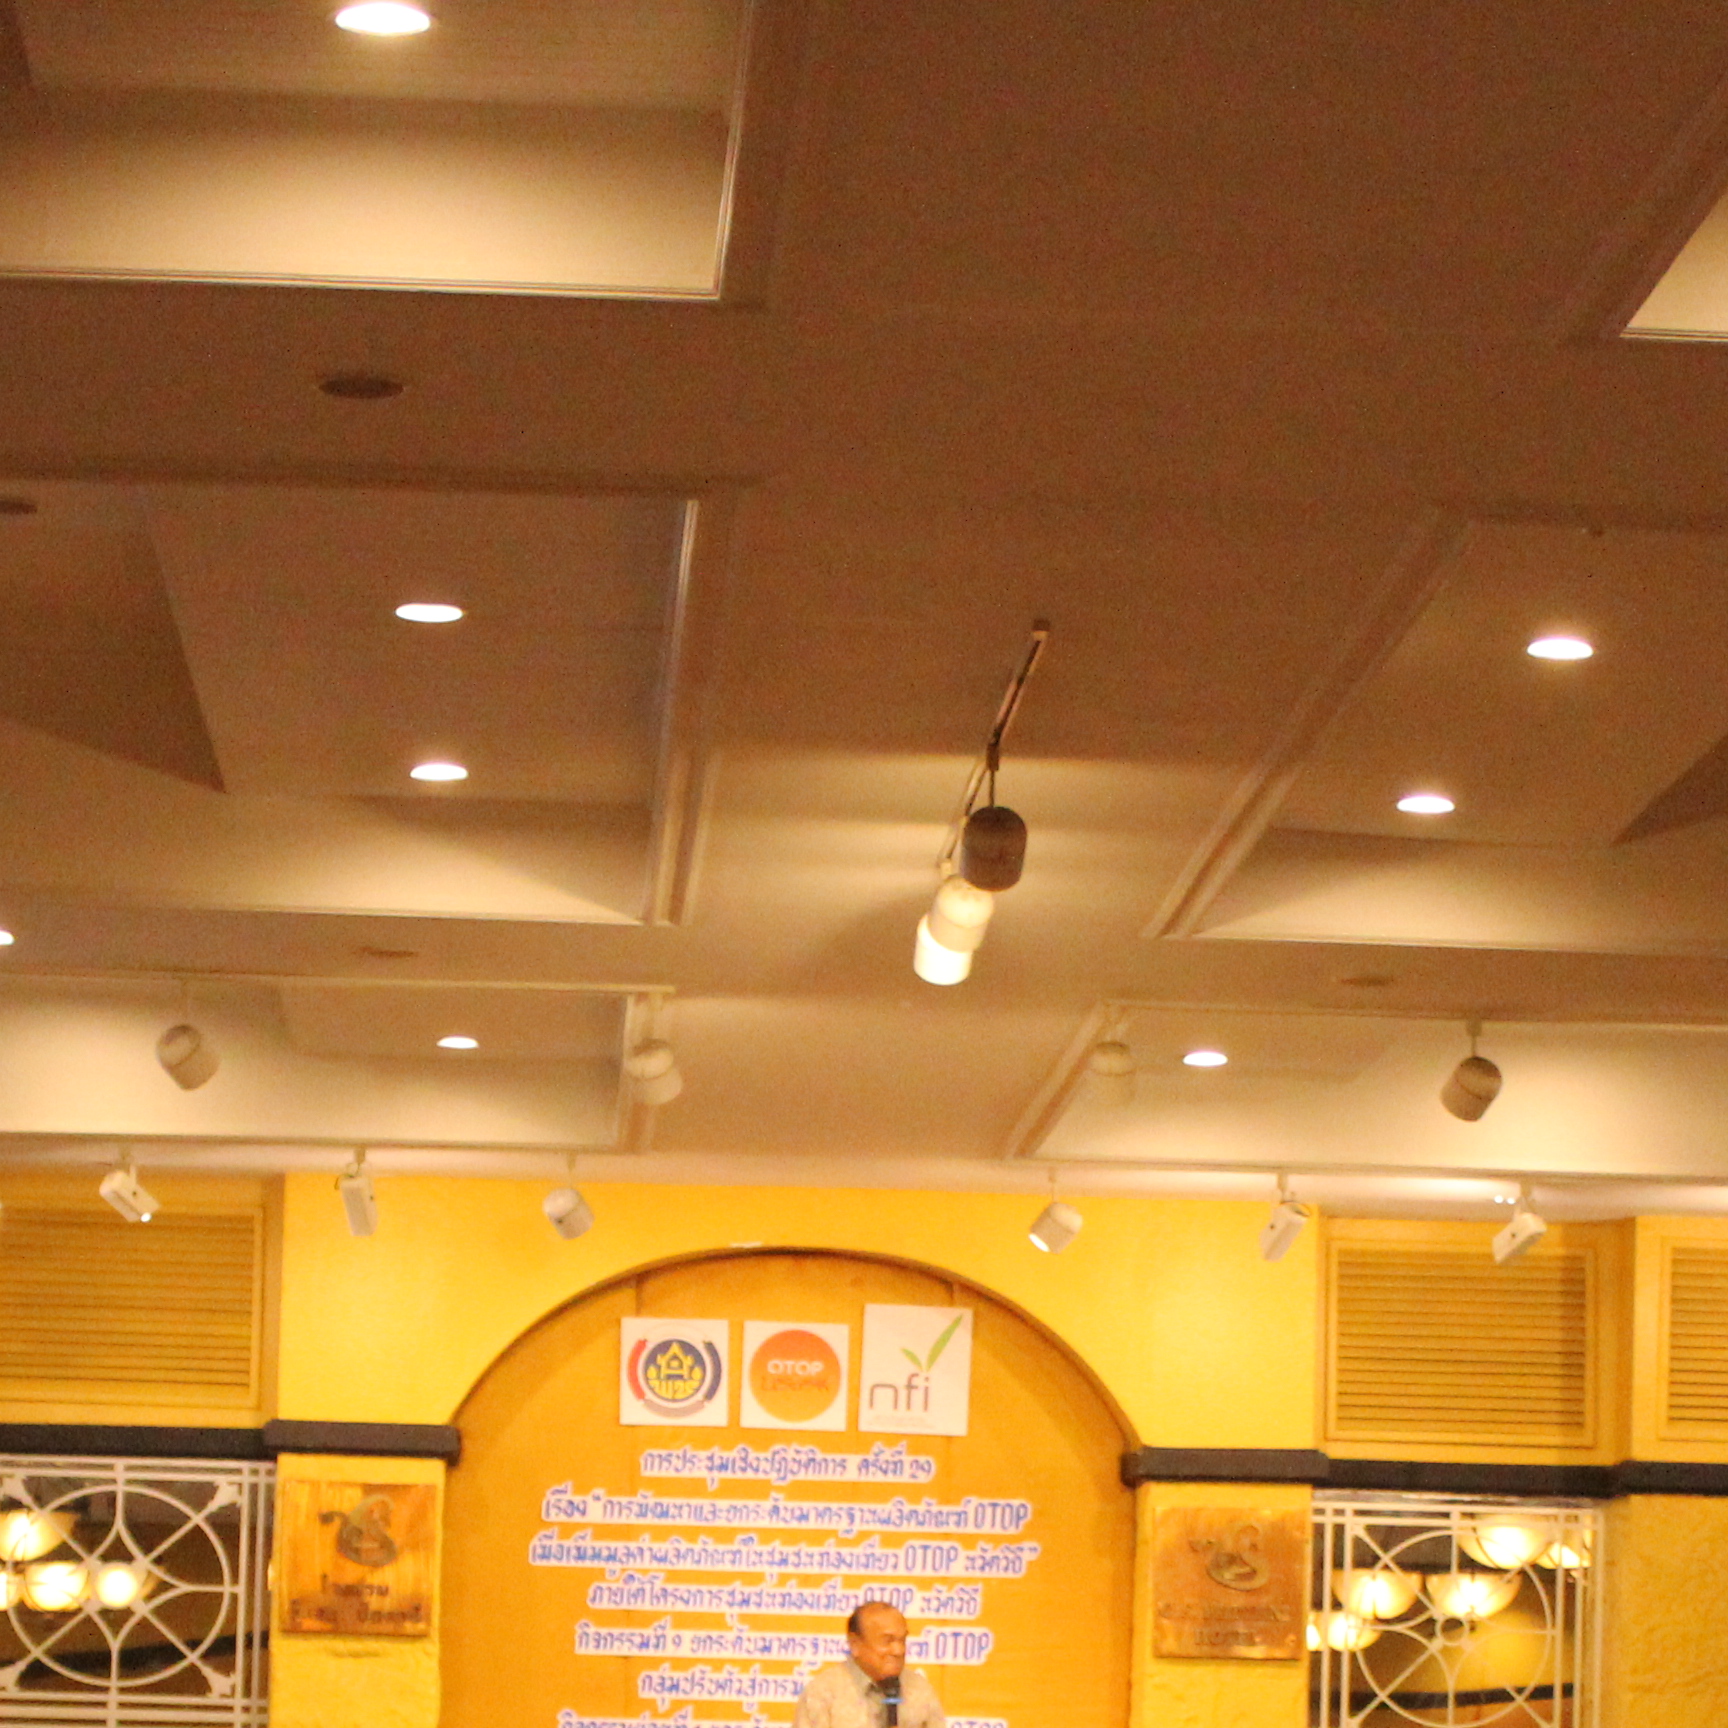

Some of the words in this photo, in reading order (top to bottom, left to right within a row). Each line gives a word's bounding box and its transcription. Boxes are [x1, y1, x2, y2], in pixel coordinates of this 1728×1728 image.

[766, 1359, 825, 1377] OTOP
[868, 1372, 930, 1412] nfi
[974, 1502, 1029, 1530] OTOP
[904, 1544, 959, 1572] OTOP
[935, 1632, 990, 1660] OTOP
